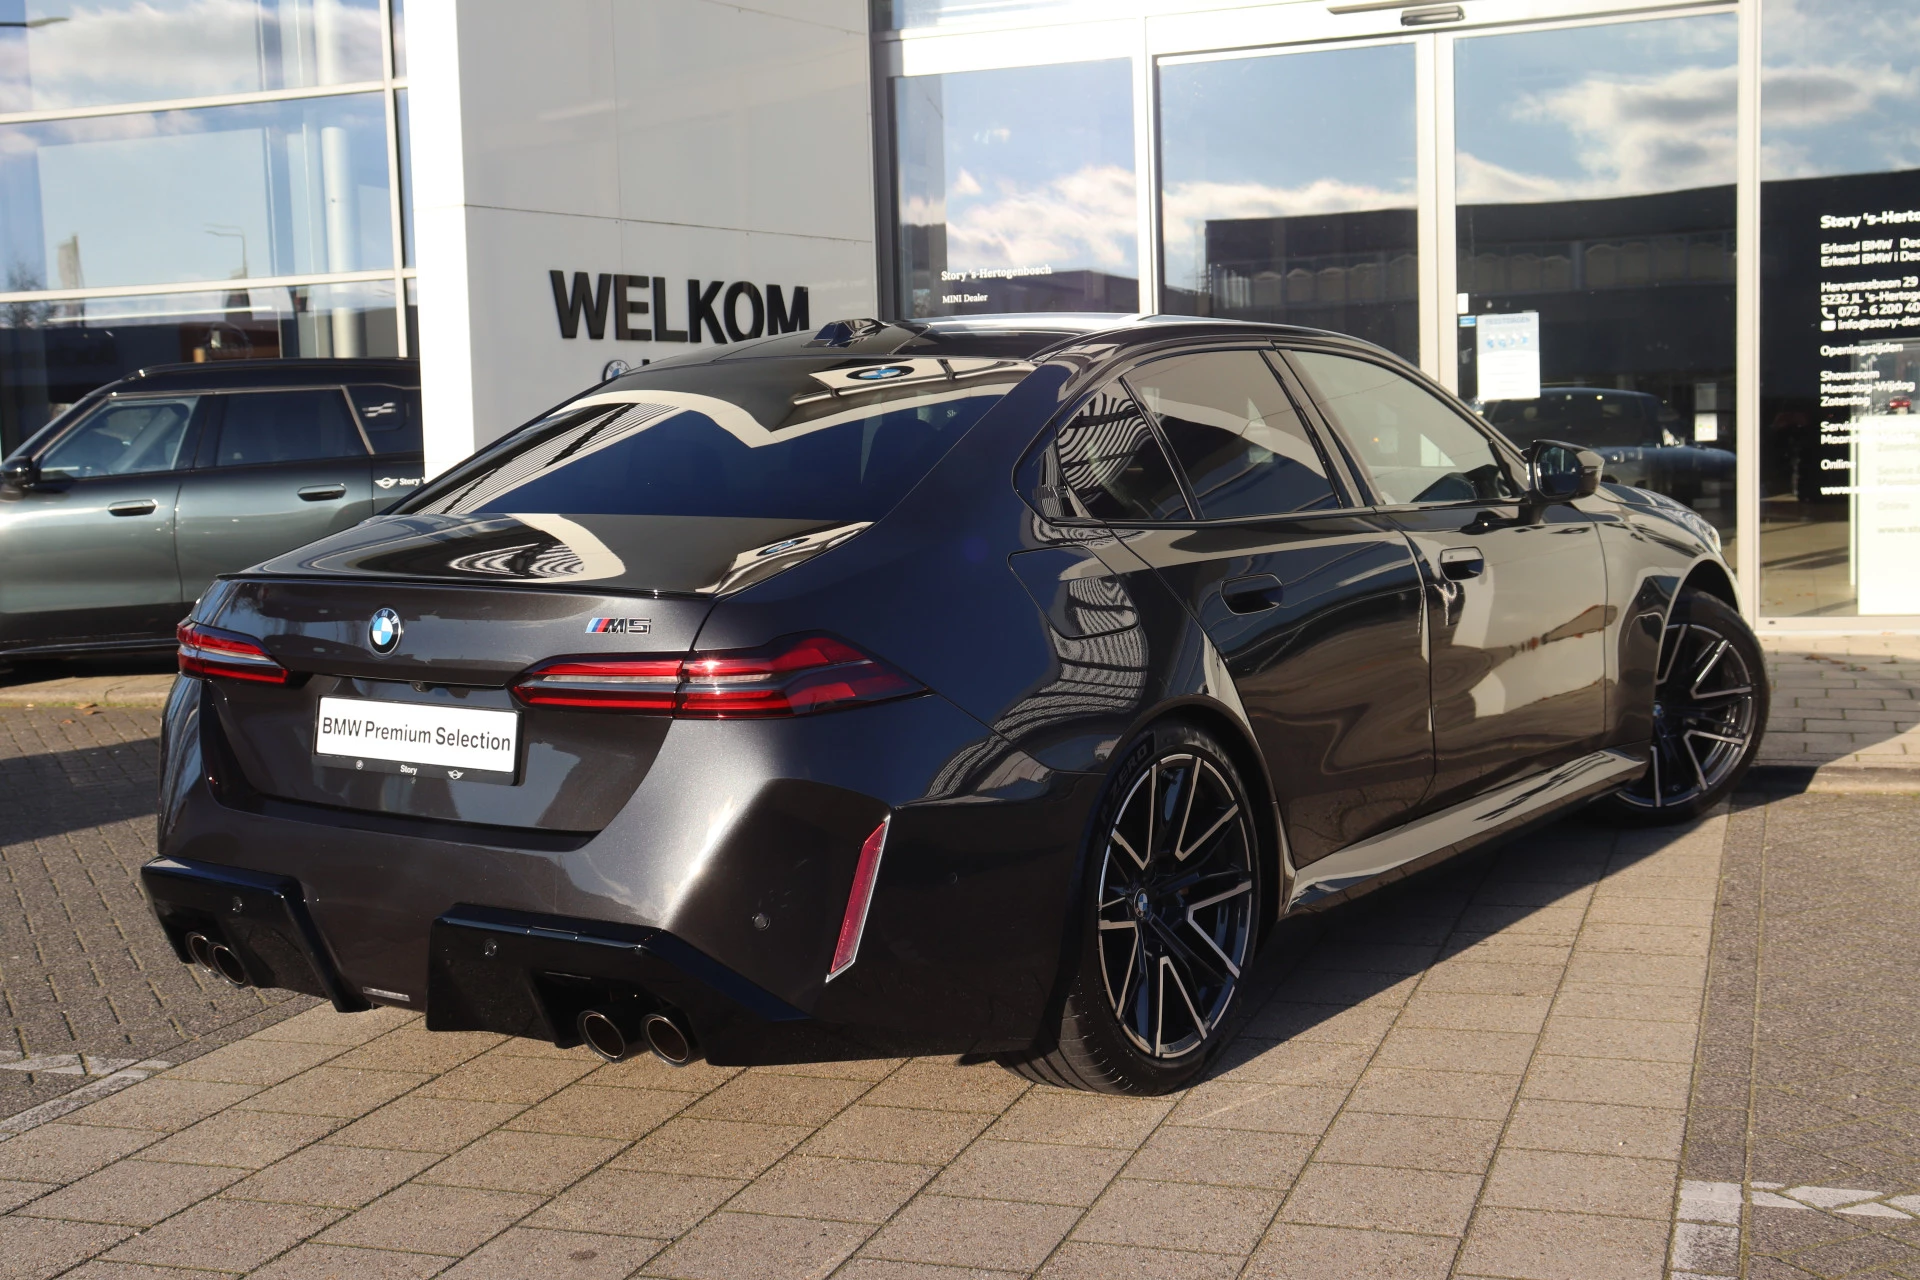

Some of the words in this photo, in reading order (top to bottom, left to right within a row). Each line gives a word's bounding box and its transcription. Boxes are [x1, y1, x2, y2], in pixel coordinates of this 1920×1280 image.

[1820, 215, 1861, 229] Story
[1821, 241, 1860, 254] Erkend
[1861, 239, 1893, 251] BMW
[1821, 254, 1860, 267] Erkend
[1861, 252, 1893, 264] BMW
[1894, 251, 1898, 262] i
[941, 270, 967, 282] Story
[969, 264, 1052, 279] 's-Hertogenbosch
[1902, 276, 1918, 288] 29
[942, 294, 962, 303] MINI
[963, 293, 988, 303] Dealer
[1821, 293, 1849, 305] 5232
[1850, 293, 1864, 304] JL
[549, 269, 809, 344] WELKOM
[1838, 305, 1860, 317] 073
[1869, 304, 1878, 316] 6
[1879, 303, 1903, 315] 200
[1820, 343, 1903, 357] Openingstijden
[1820, 370, 1880, 382] Showroom
[1820, 380, 1916, 394] Maandag-Vrijdag
[1820, 395, 1871, 407] Zaterdag
[399, 478, 420, 486] Story
[600, 617, 651, 634] M5
[322, 717, 362, 737] BMW
[365, 720, 431, 744] Premium
[435, 726, 511, 751] Selection
[400, 764, 418, 776] Story
